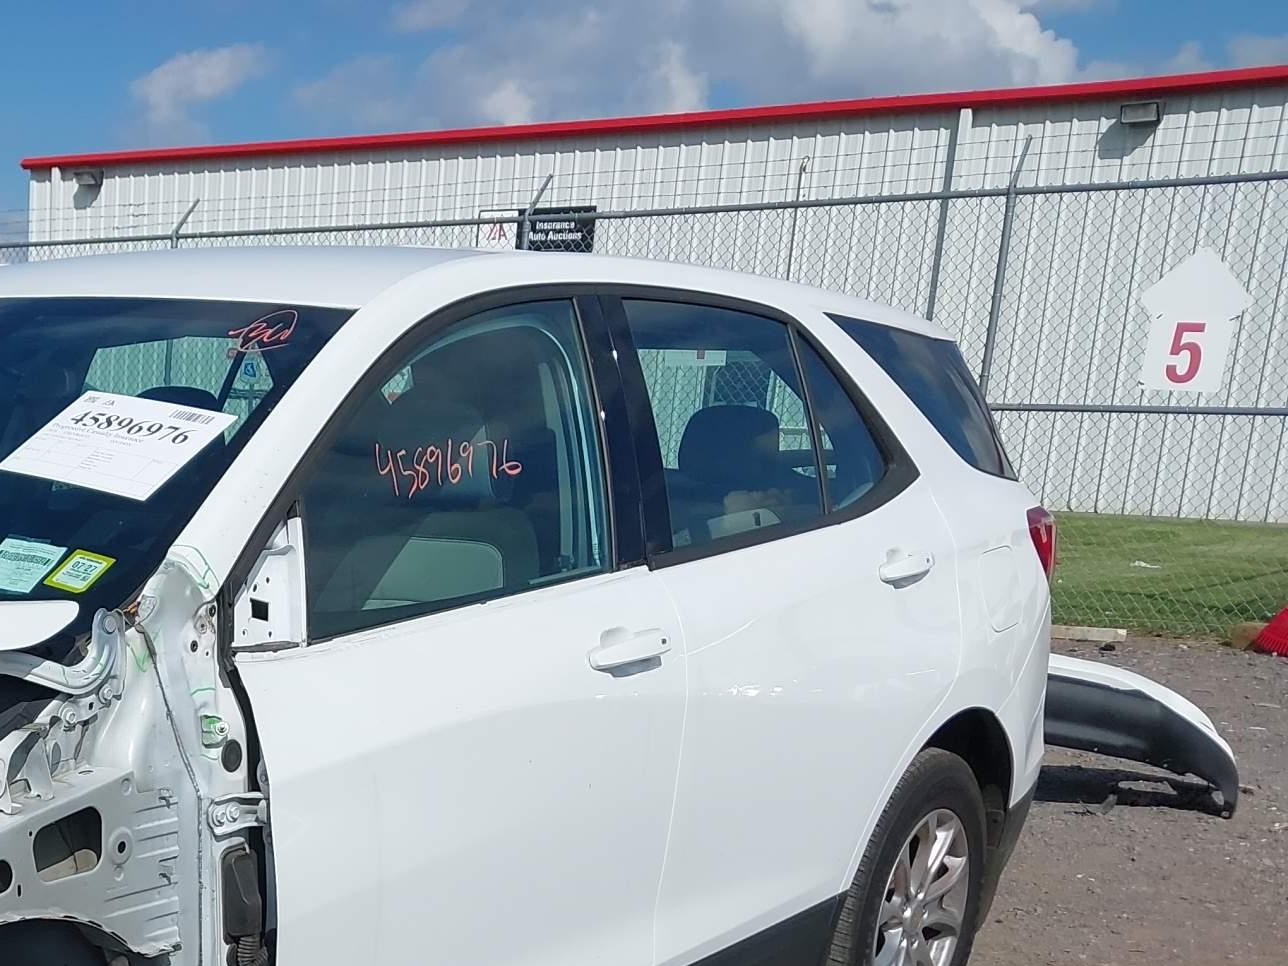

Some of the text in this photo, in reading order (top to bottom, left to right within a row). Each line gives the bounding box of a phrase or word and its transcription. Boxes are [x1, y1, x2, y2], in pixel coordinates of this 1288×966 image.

[528, 230, 582, 241] Auto Auctions
[535, 221, 576, 230] Insurance
[1165, 321, 1207, 384] 5
[70, 410, 198, 444] 45896976
[375, 438, 523, 499] 45896976
[71, 560, 86, 570] 07
[83, 564, 98, 573] 27
